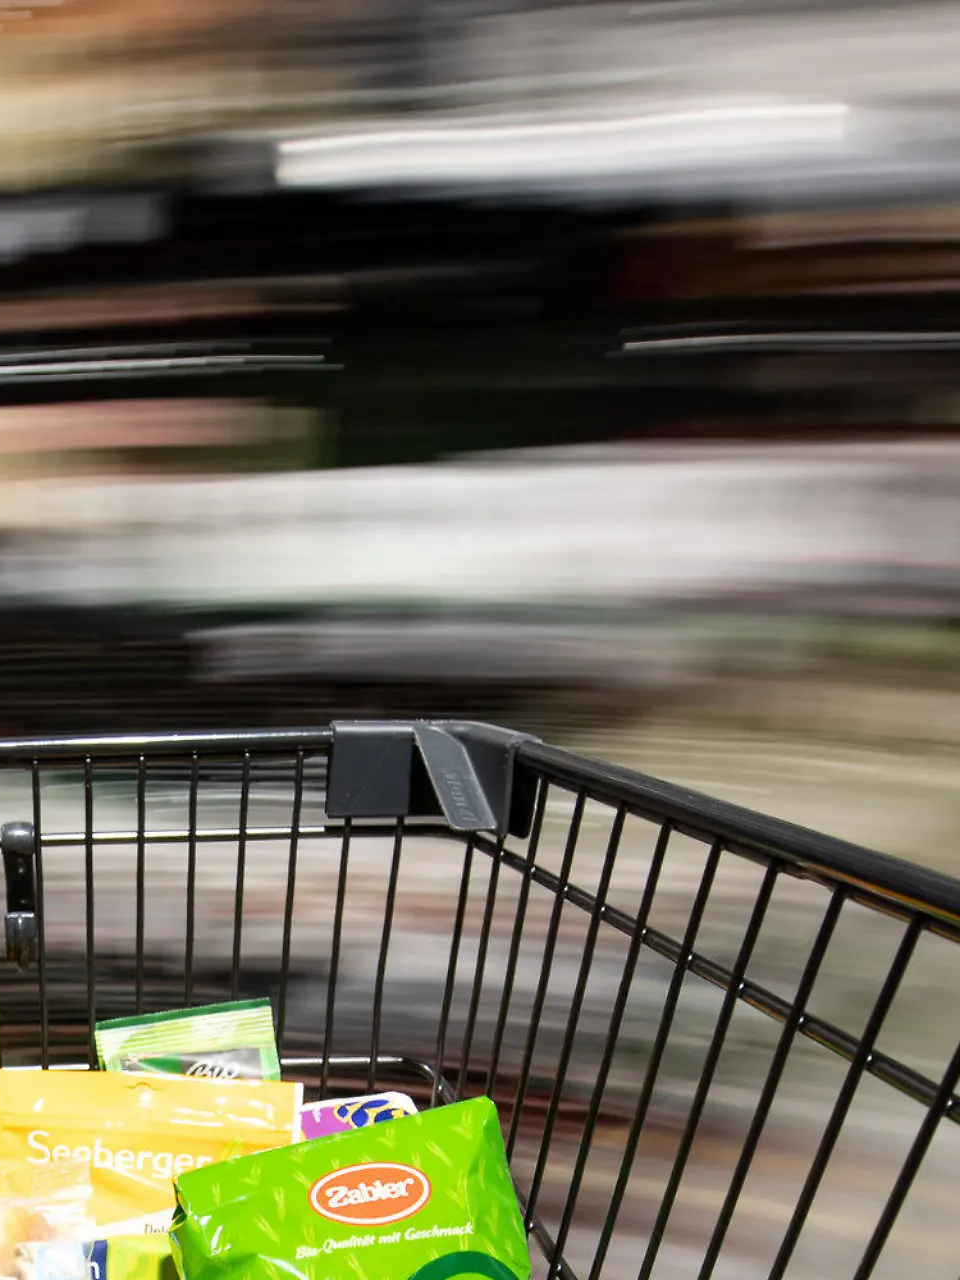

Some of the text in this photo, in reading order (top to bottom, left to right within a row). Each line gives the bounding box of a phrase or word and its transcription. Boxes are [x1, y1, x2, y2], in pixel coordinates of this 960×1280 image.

[26, 1129, 212, 1176] Seeberger
[326, 1176, 414, 1208] Zabler
[295, 1220, 474, 1260] Bio-Qualität mit Geschmack
